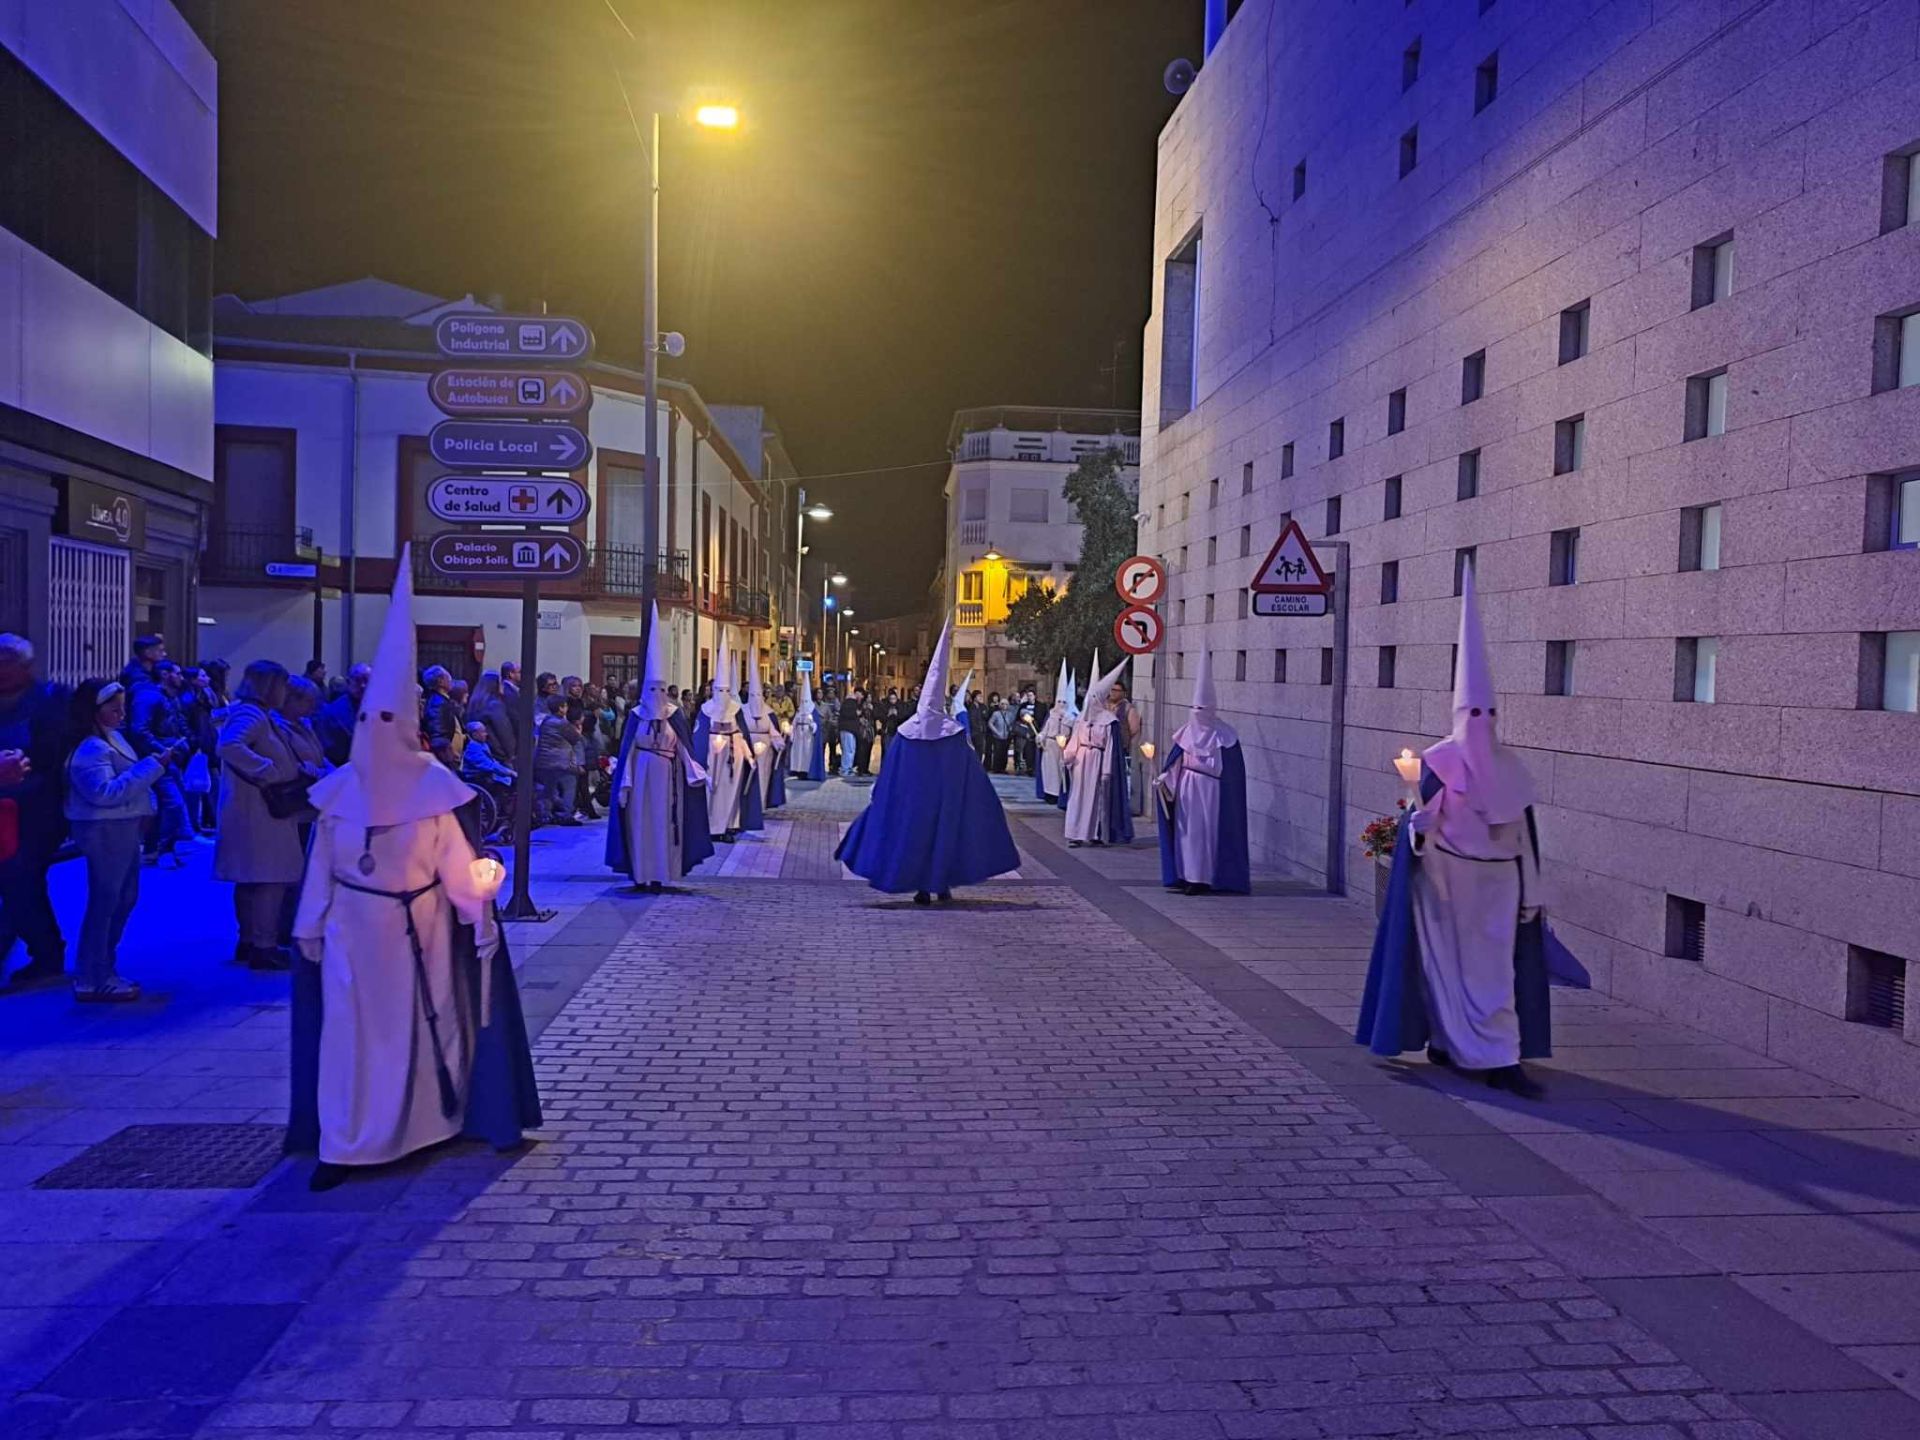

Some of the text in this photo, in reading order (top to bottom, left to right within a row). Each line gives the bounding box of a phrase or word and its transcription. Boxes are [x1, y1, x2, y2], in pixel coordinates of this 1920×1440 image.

[450, 321, 505, 335] Polígono
[451, 338, 510, 351] Industrial
[447, 375, 515, 388] Estación de
[447, 392, 509, 404] Autobuses
[498, 439, 538, 453] Local
[444, 484, 489, 496] Centro
[444, 500, 501, 512] de Salud
[455, 542, 497, 552] Palacio
[443, 555, 509, 565] Obispo Solís
[1274, 595, 1307, 603] CAMINO
[1271, 604, 1310, 612] ESCOLAR
